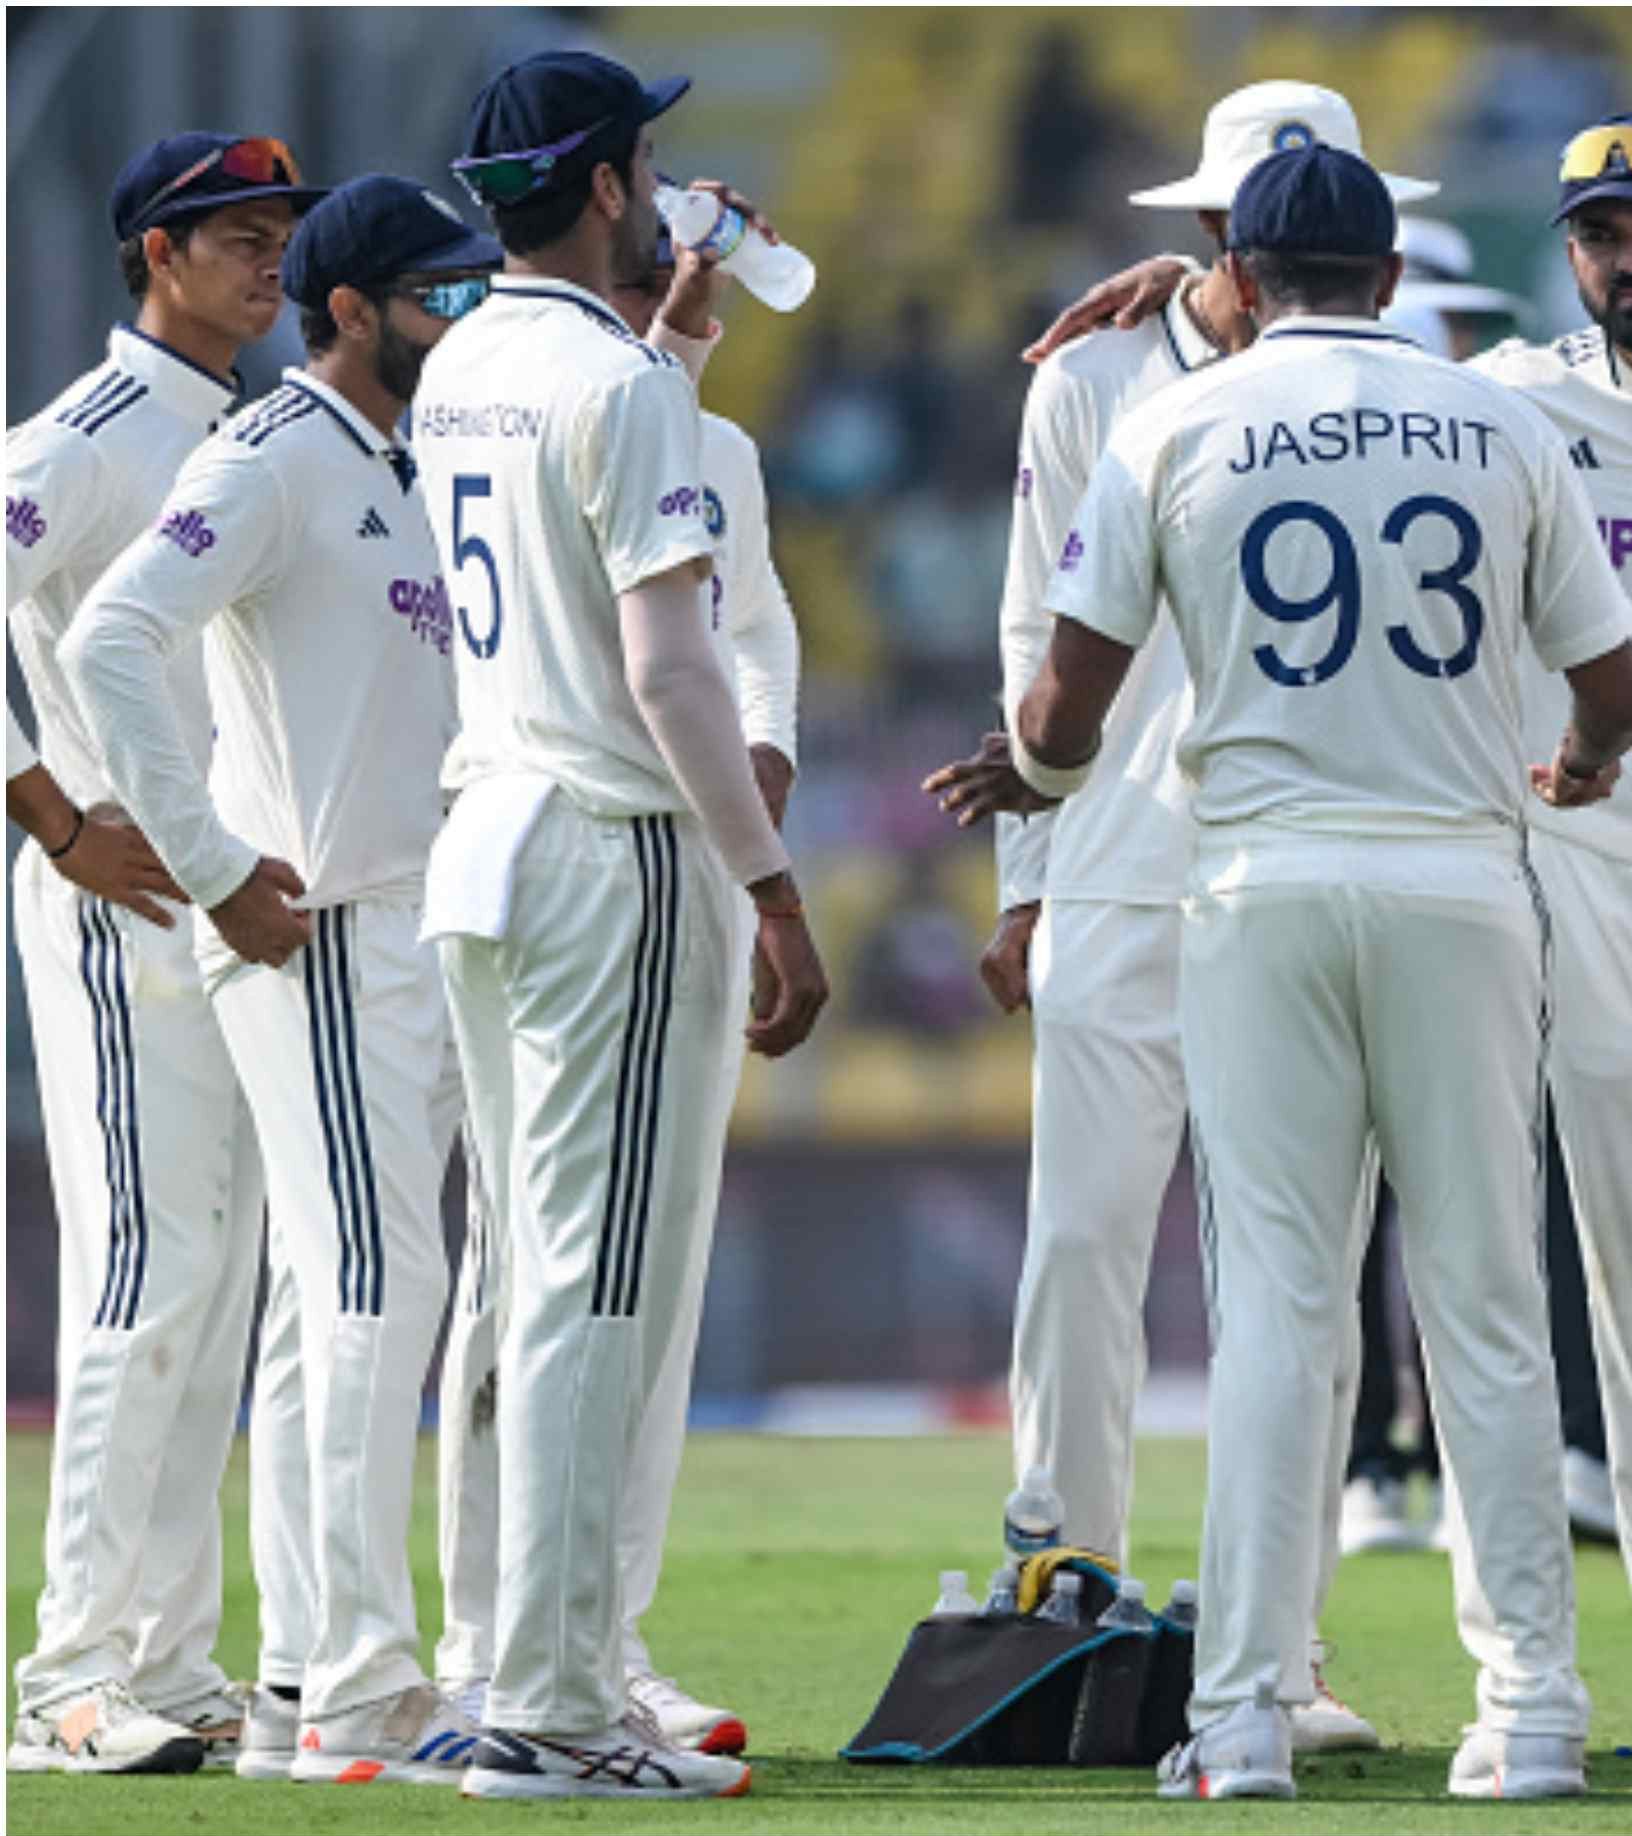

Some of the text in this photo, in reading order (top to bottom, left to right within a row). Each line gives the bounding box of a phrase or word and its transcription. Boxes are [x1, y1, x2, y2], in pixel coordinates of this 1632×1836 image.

[1229, 408, 1496, 474] JASPRIT
[449, 475, 501, 659] 5
[1240, 495, 1485, 687] 93
